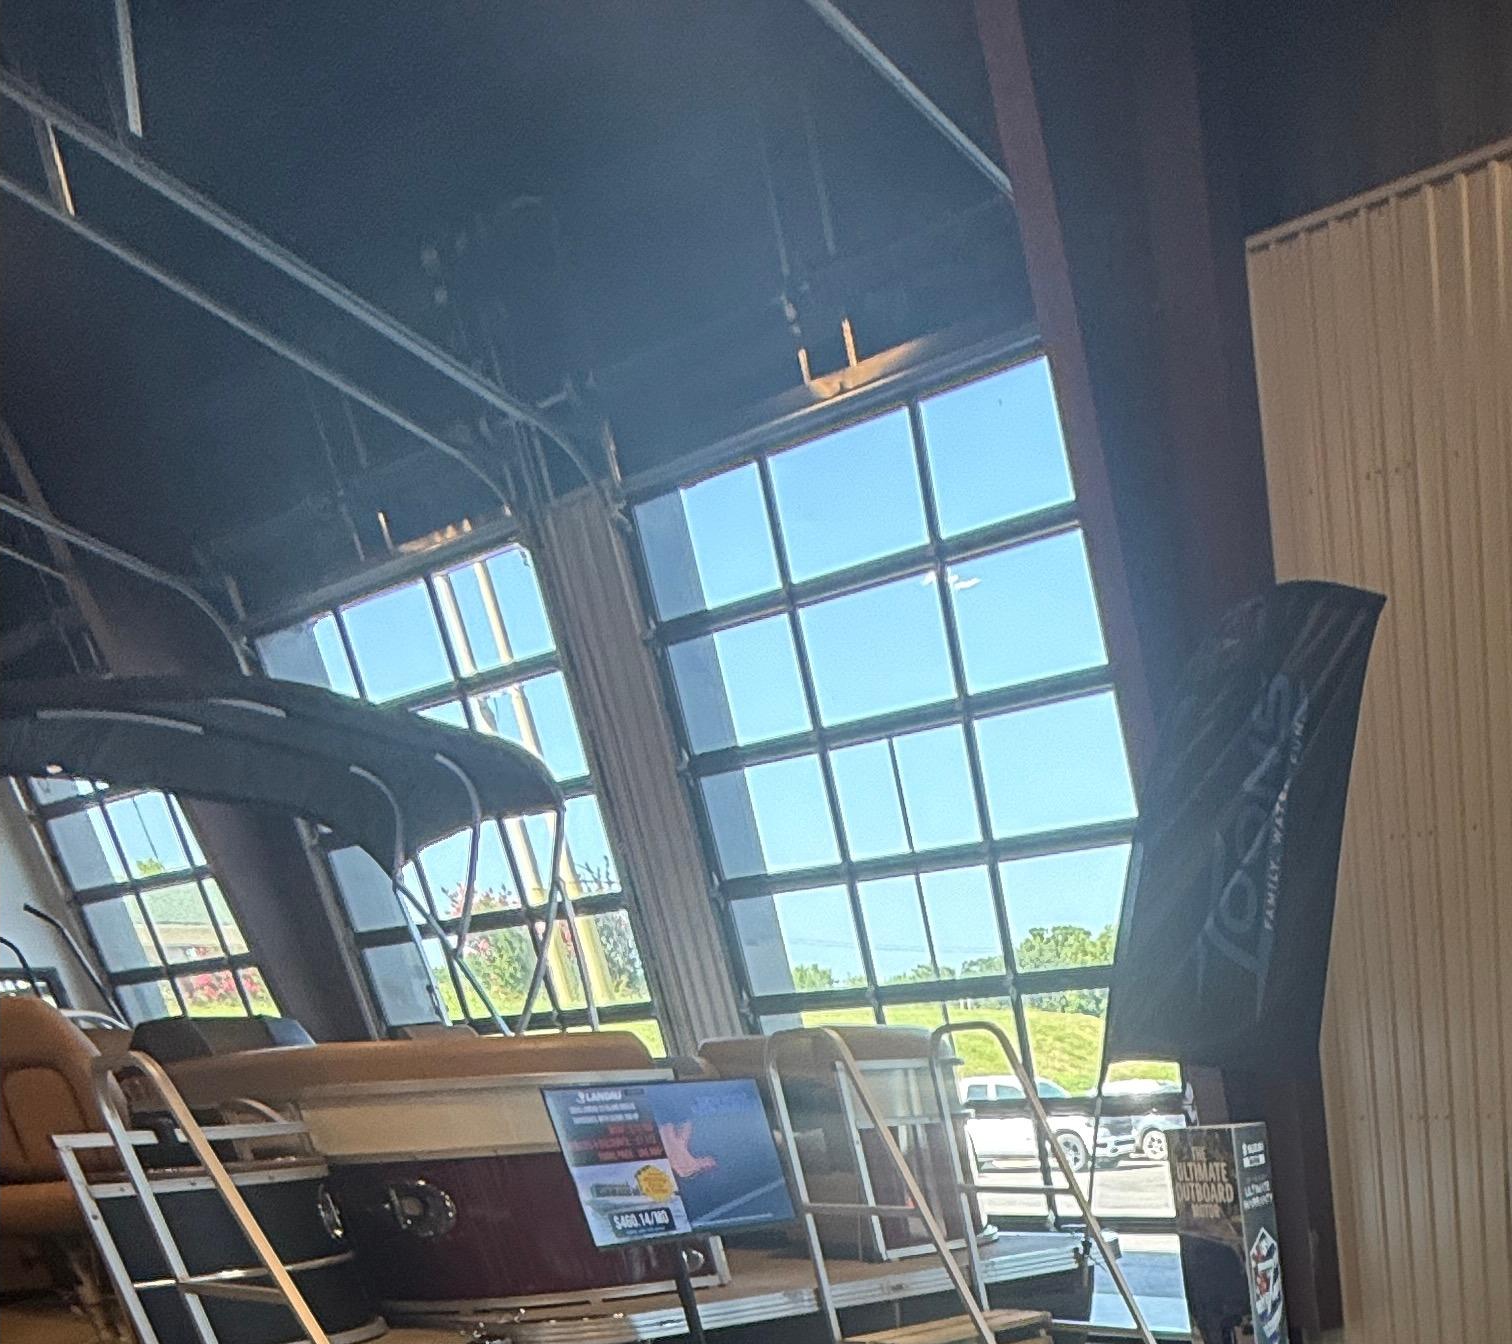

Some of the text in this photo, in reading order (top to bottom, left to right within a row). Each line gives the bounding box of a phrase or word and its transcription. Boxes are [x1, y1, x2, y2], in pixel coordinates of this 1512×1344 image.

[1191, 1145, 1207, 1160] THE
[1176, 1162, 1228, 1182] ULTIMATE
[1176, 1182, 1234, 1203] OUTBOARD
[1191, 1203, 1222, 1218] MOTOR
